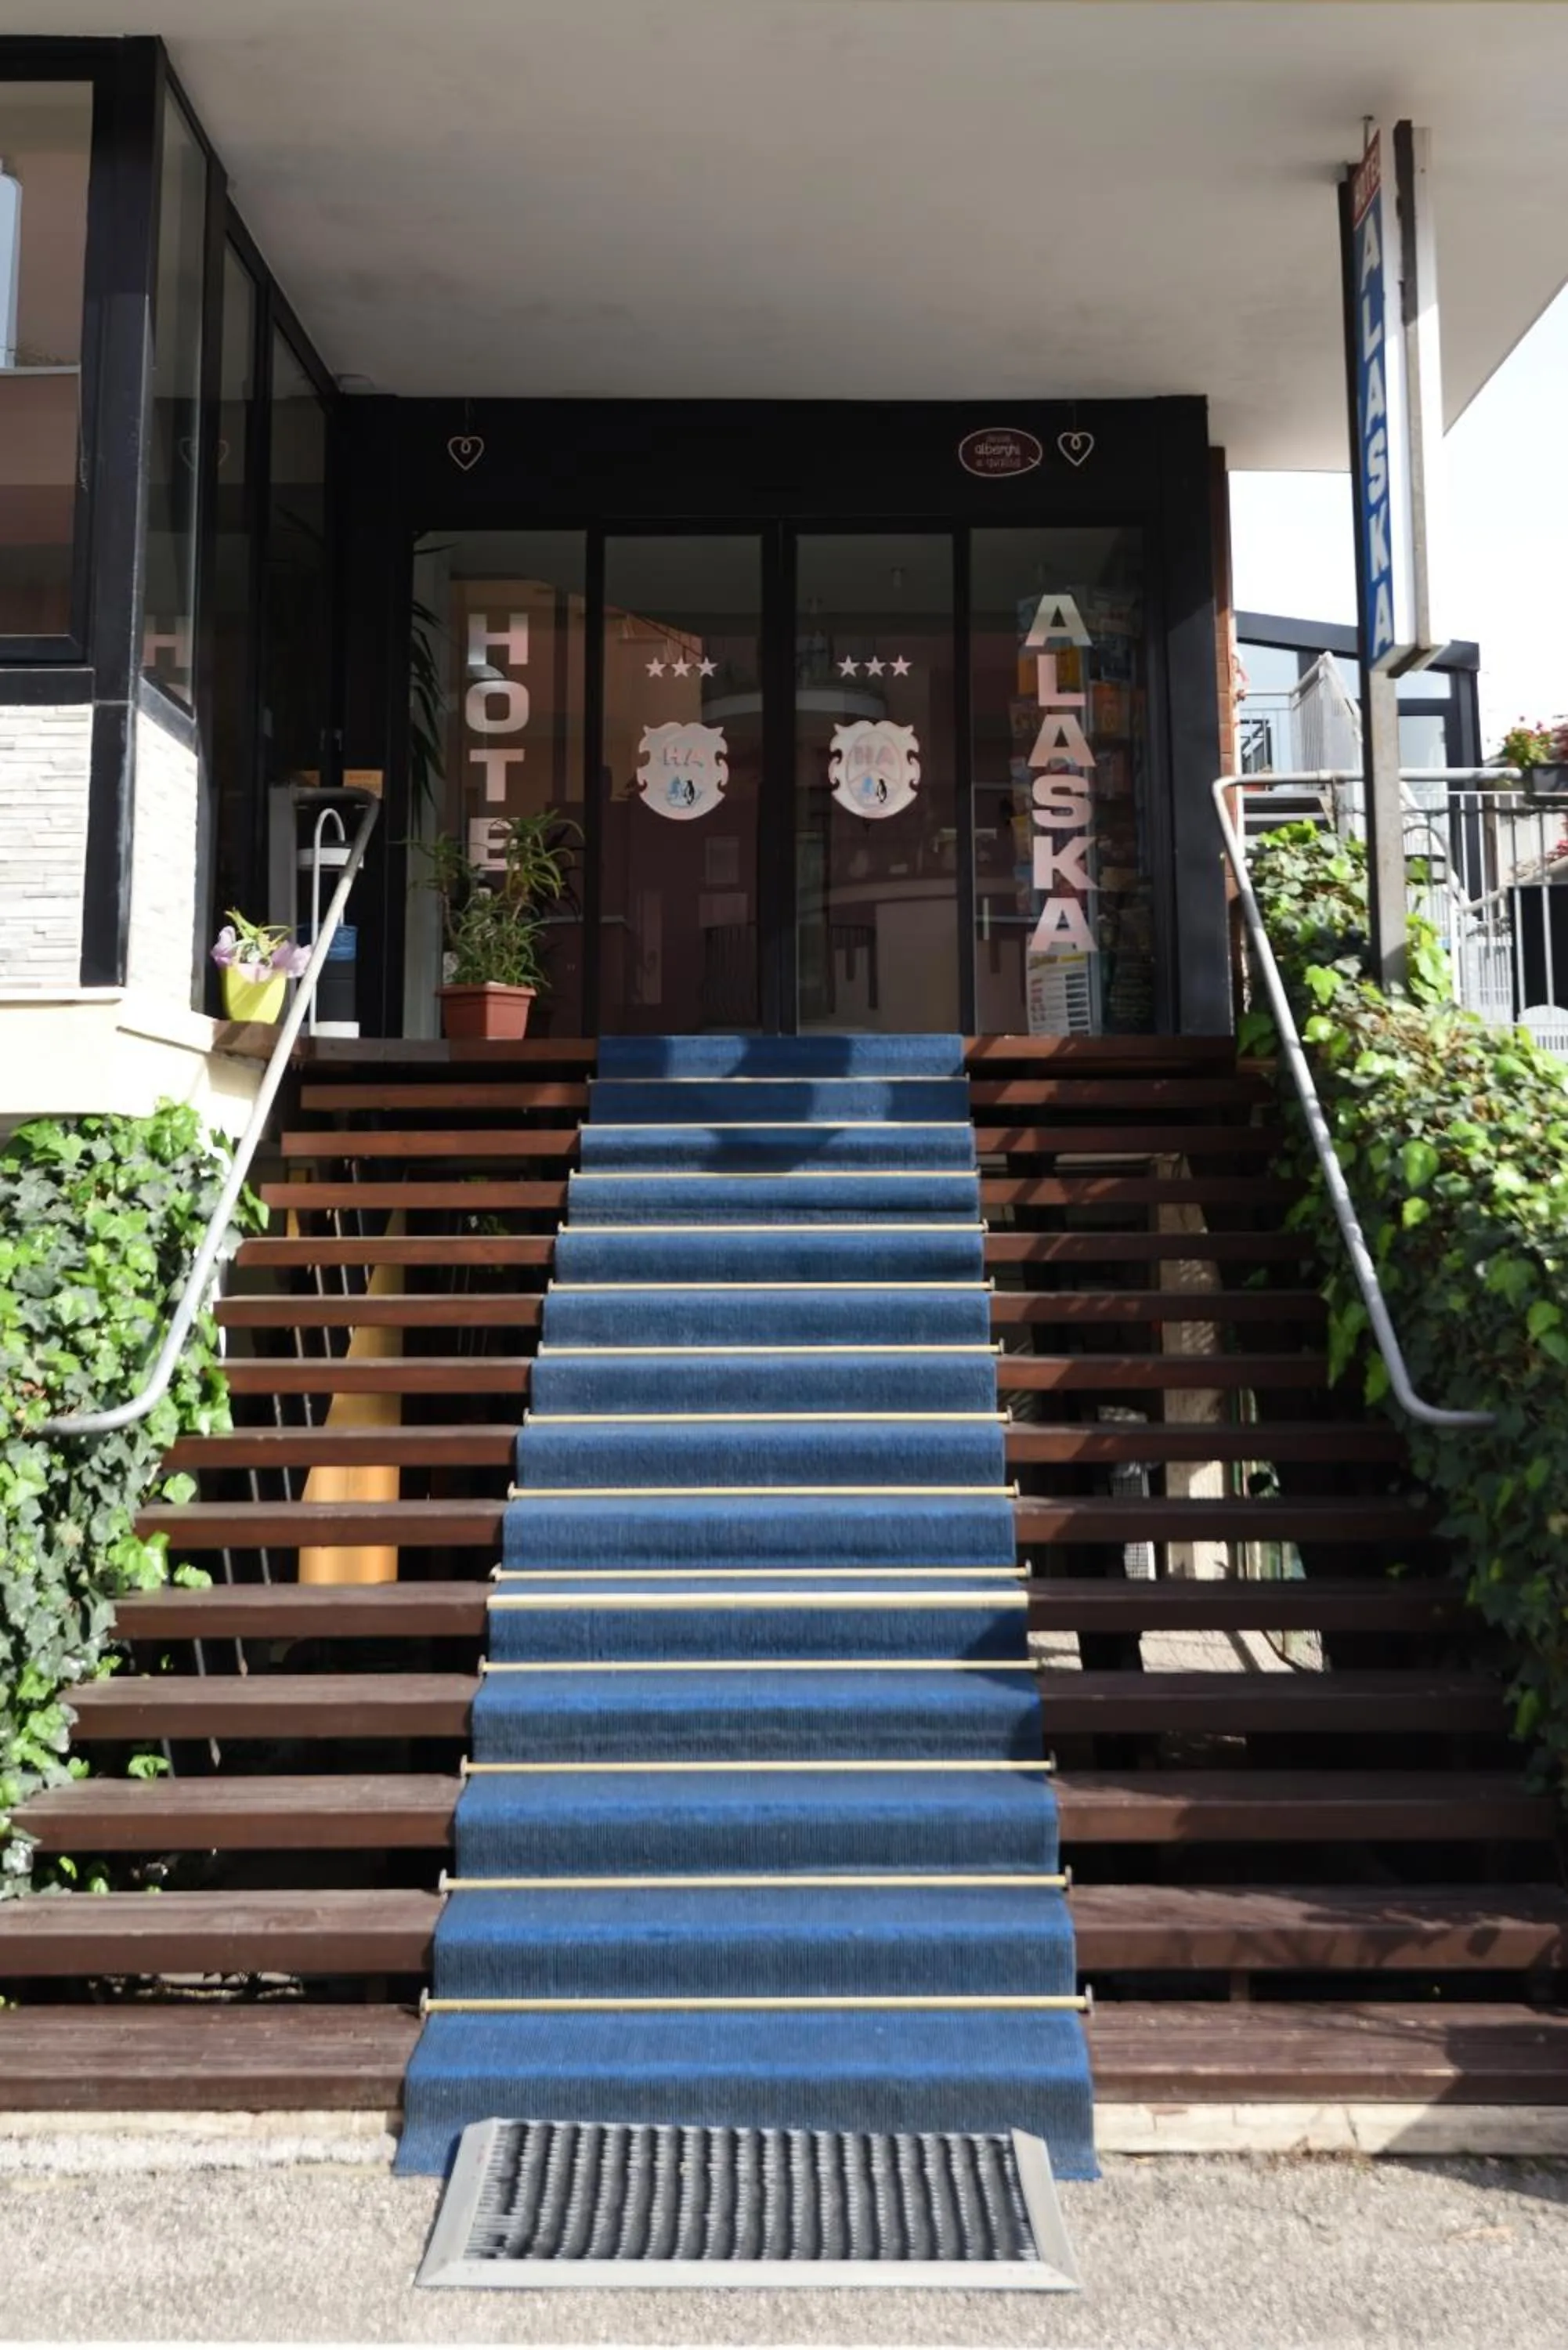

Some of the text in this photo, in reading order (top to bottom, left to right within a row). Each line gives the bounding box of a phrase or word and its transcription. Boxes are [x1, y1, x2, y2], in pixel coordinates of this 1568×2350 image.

[1360, 210, 1393, 660] ALASKA
[465, 613, 529, 891] HOTE
[1024, 595, 1098, 952] ALASKA
